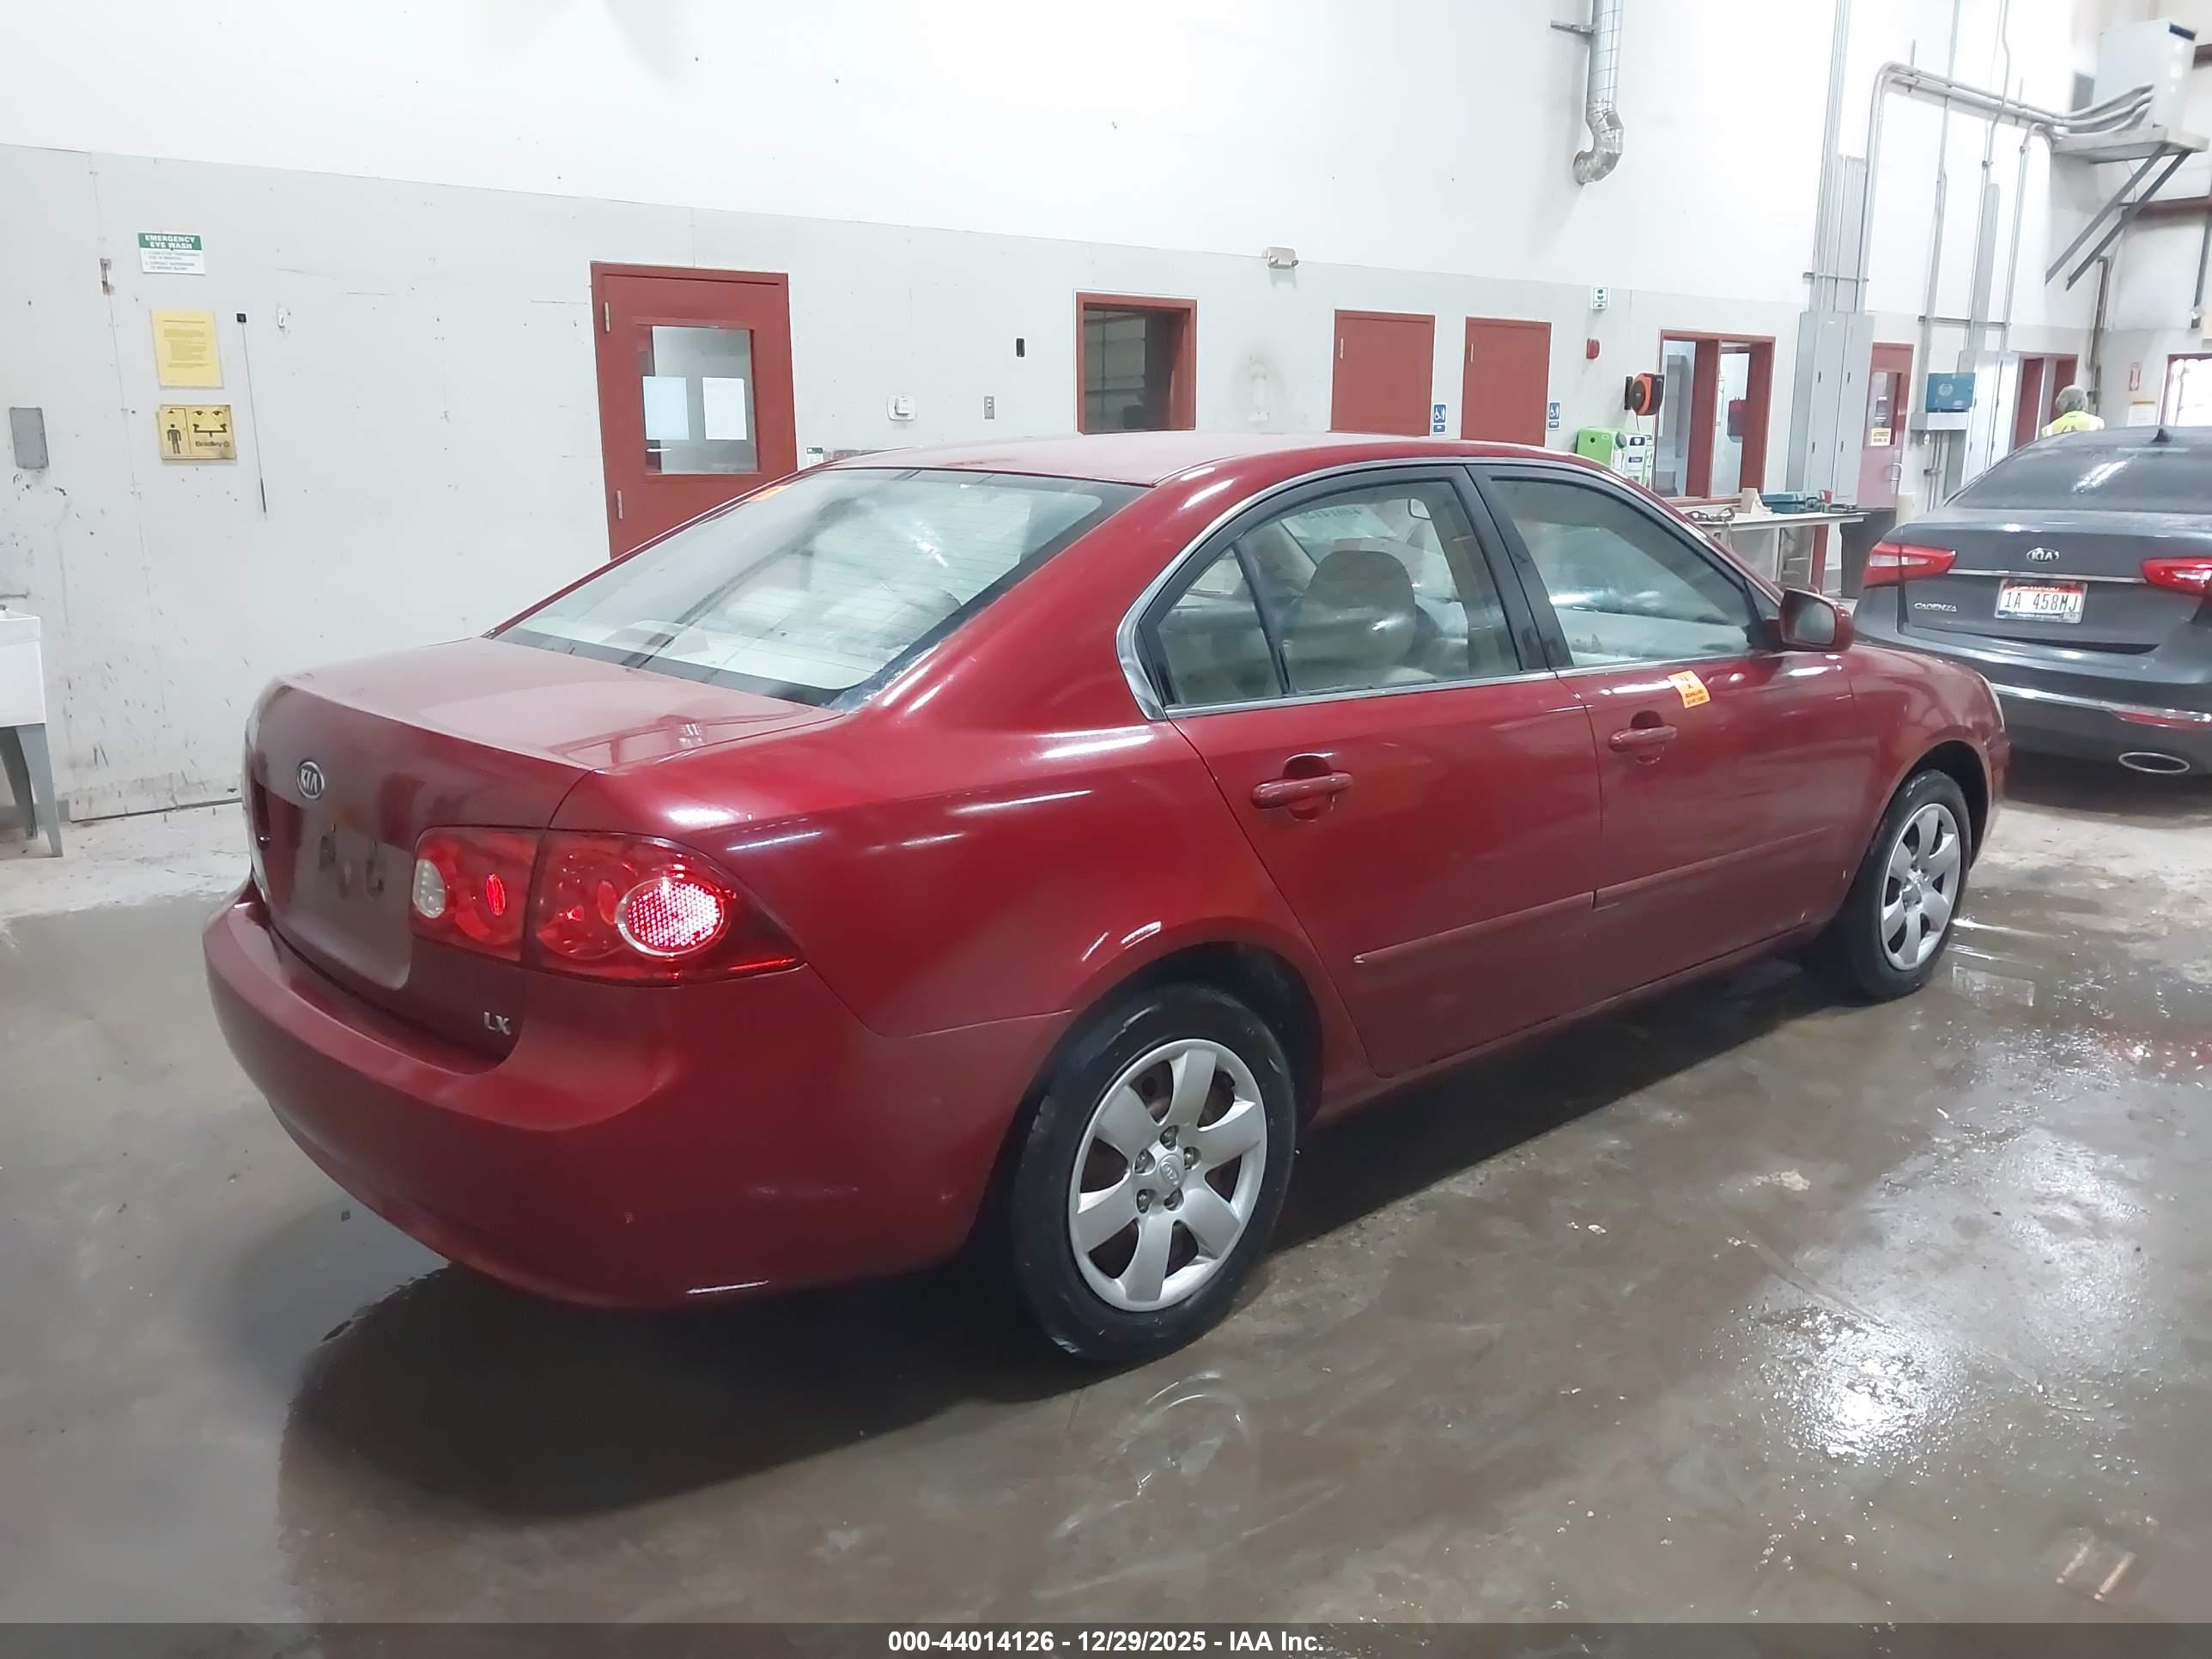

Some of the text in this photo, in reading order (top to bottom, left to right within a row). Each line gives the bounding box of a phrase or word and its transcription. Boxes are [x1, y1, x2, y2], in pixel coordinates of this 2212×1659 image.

[144, 234, 196, 243] EMERGENCY
[1914, 602, 1958, 612] CADENZA
[2004, 592, 2078, 612] 1A 458MJ
[483, 1011, 512, 1036] LX
